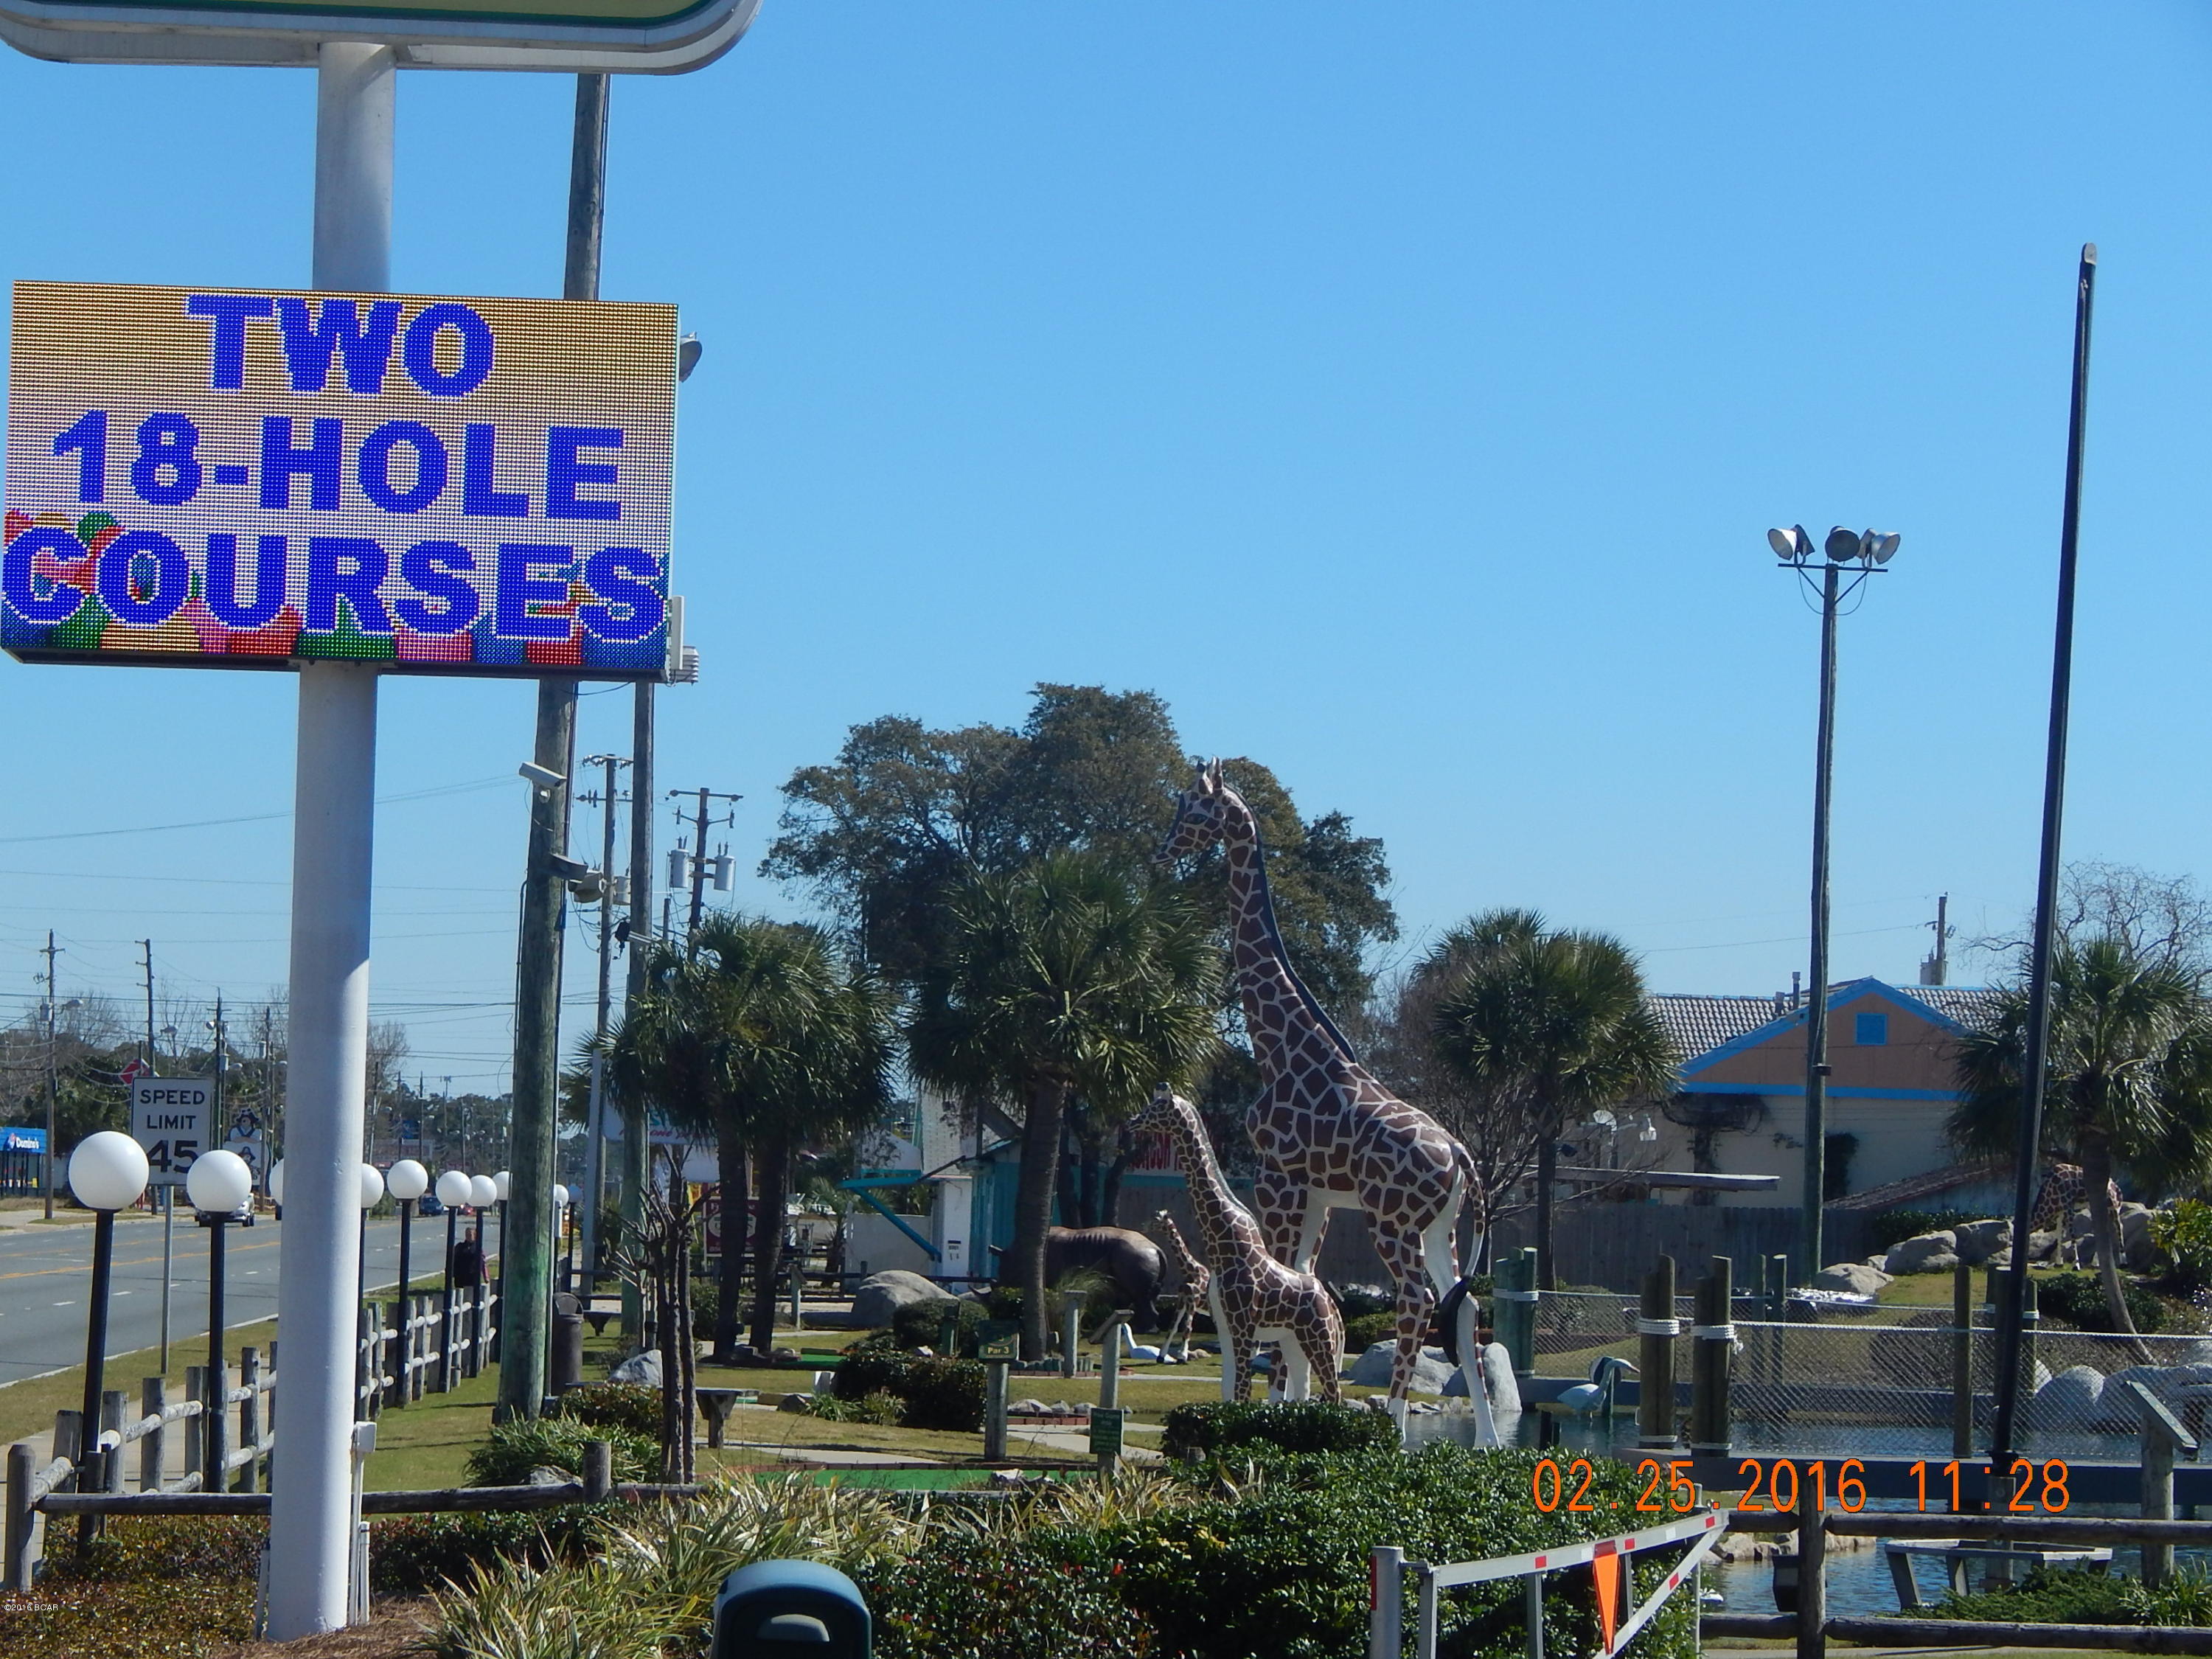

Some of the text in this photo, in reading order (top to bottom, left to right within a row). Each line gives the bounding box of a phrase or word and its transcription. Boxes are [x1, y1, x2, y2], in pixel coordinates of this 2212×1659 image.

[185, 295, 494, 400] TWO
[54, 410, 625, 521] 18-HOLE
[2, 526, 667, 644] COURSES
[139, 1089, 205, 1105] SPEED
[147, 1114, 196, 1130] LIMIT
[16, 1137, 39, 1149] Domino's
[147, 1139, 200, 1174] 45
